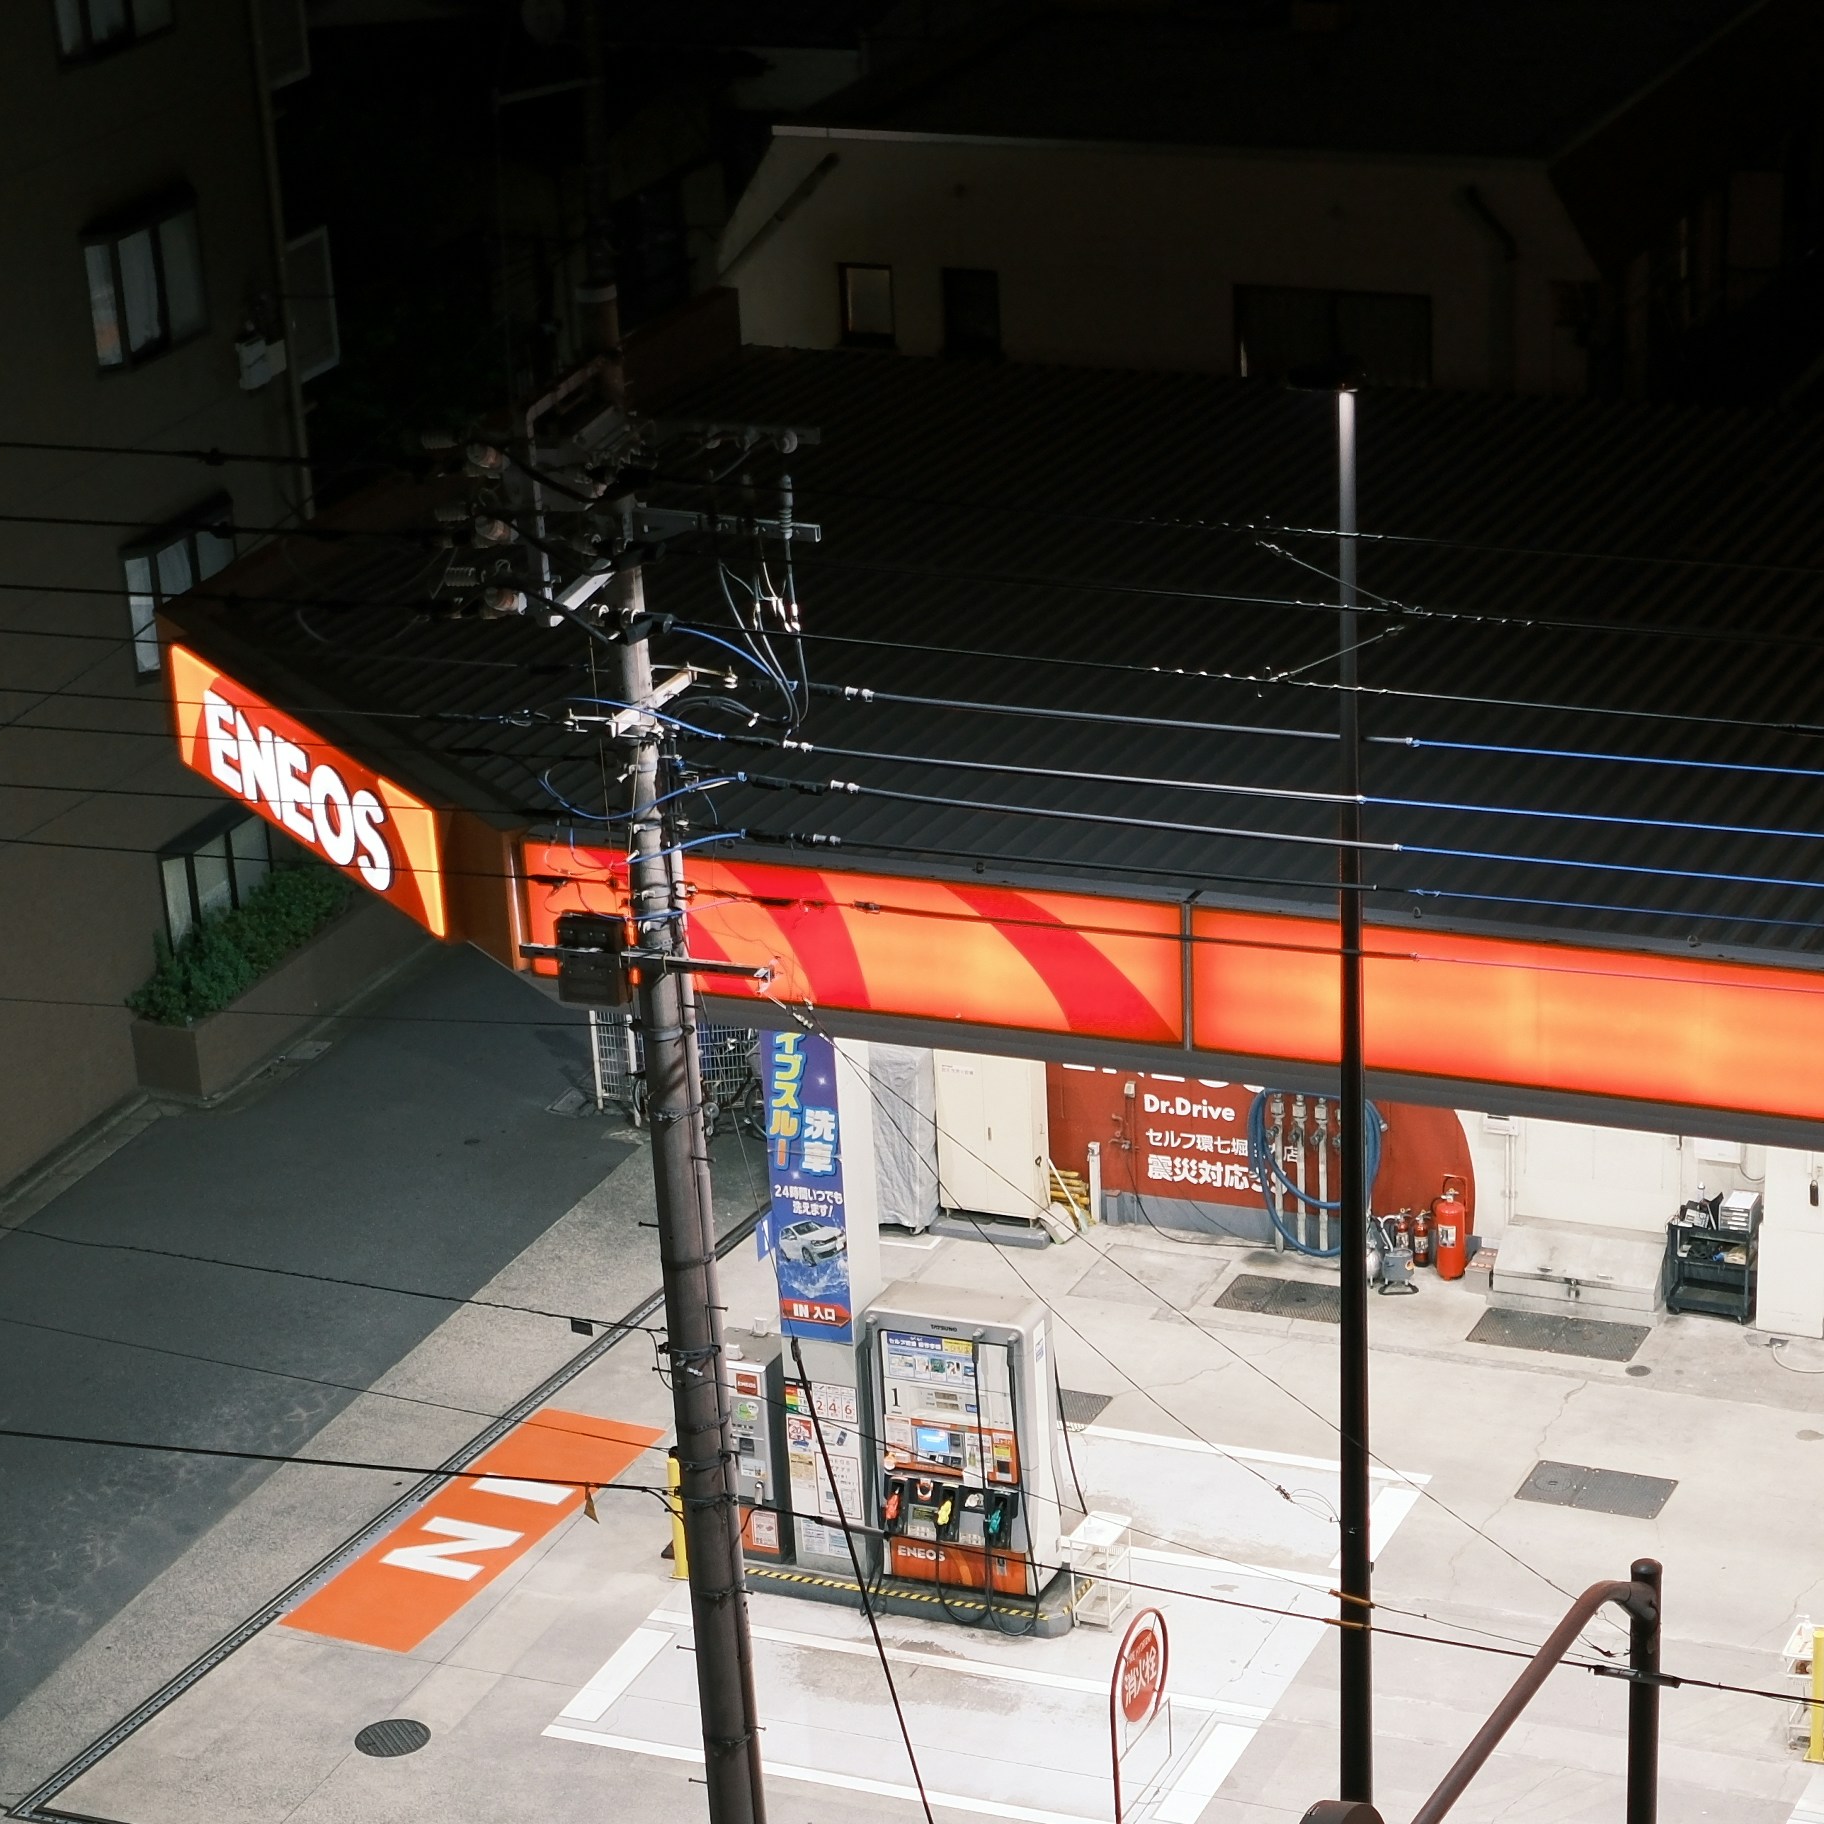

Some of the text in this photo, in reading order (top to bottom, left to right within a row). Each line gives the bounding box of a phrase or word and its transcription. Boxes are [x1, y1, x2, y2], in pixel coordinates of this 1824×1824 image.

[202, 688, 392, 893] ENEOS
[1143, 1094, 1236, 1122] Dr.Drive
[801, 1108, 836, 1173] 洗車
[1145, 1127, 1298, 1163] セルフ環七堀店
[774, 1184, 844, 1204] 24時間いつでも
[793, 1303, 836, 1322] IN 入口
[891, 1387, 901, 1407] 1
[379, 1472, 576, 1582] IN
[897, 1545, 946, 1562] ENEOS
[1124, 1646, 1157, 1708] 消火栓
